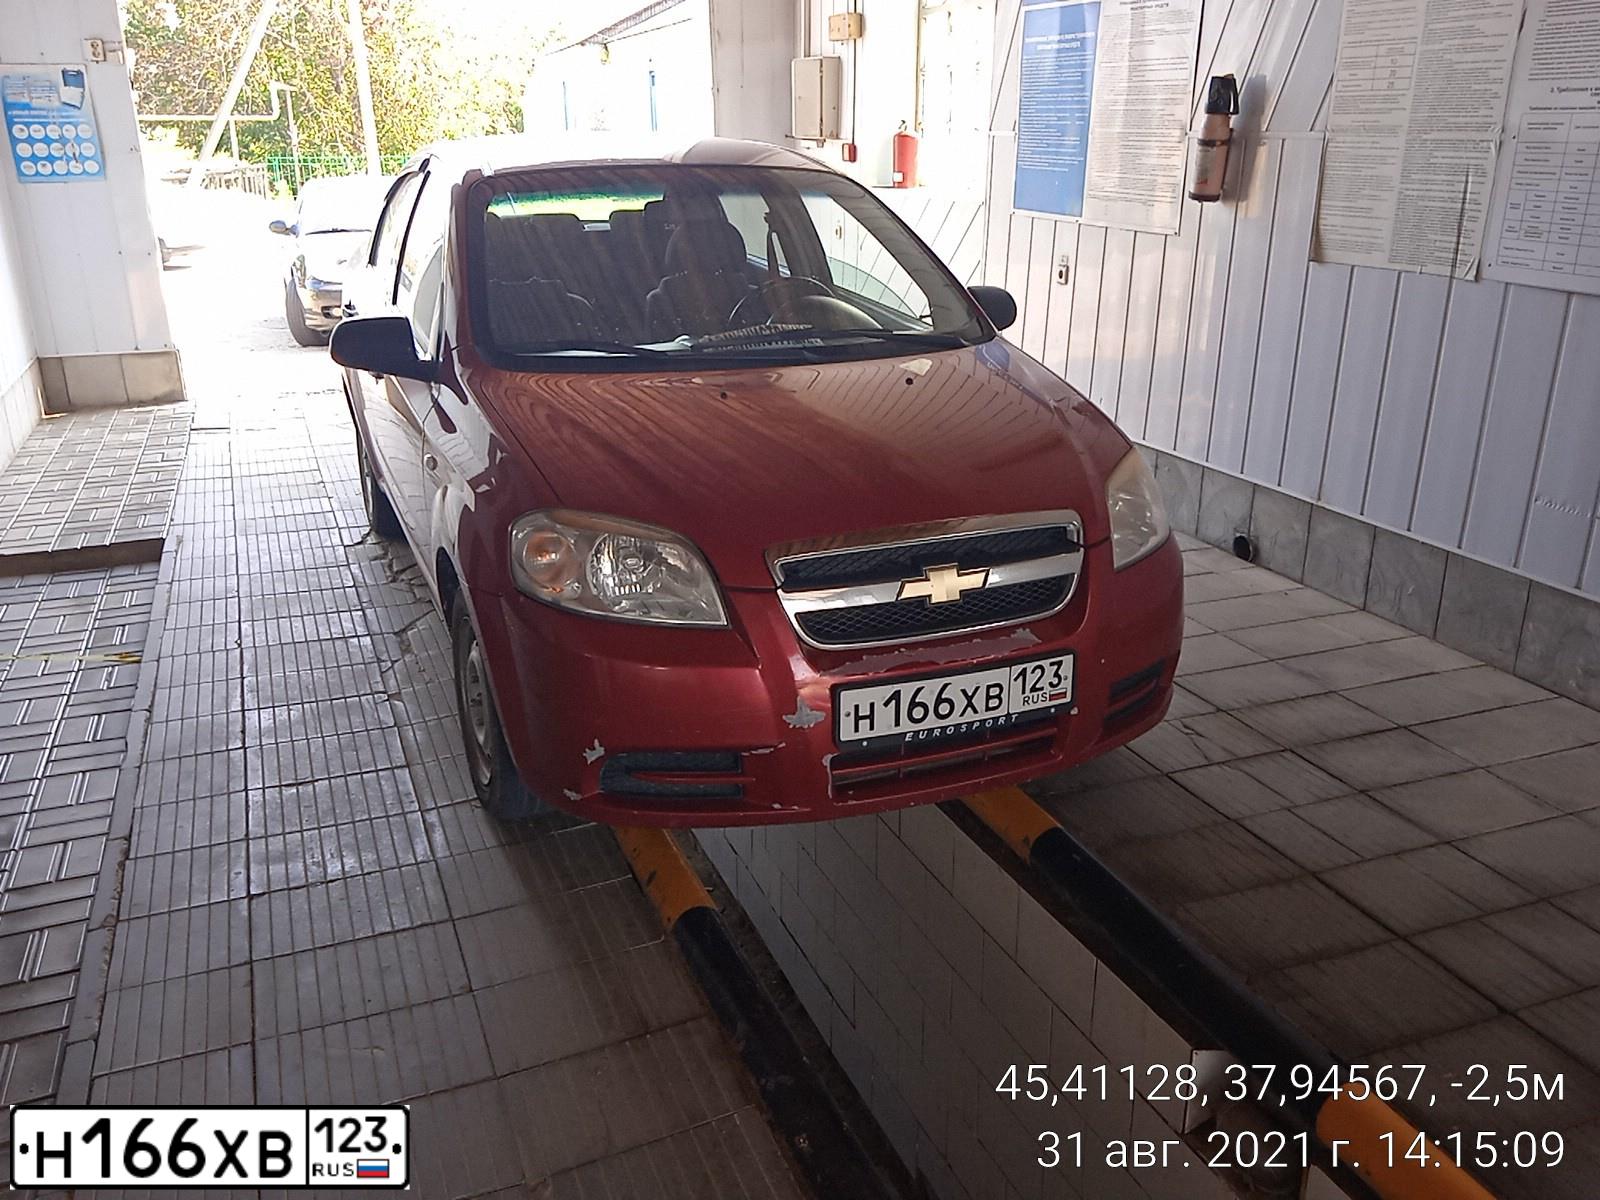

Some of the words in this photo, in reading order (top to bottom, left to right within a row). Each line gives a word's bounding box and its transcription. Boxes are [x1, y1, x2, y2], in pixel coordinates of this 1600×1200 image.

[1013, 660, 1064, 695] 123
[1022, 692, 1048, 707] RUS
[904, 713, 1019, 742] EUROSPORT
